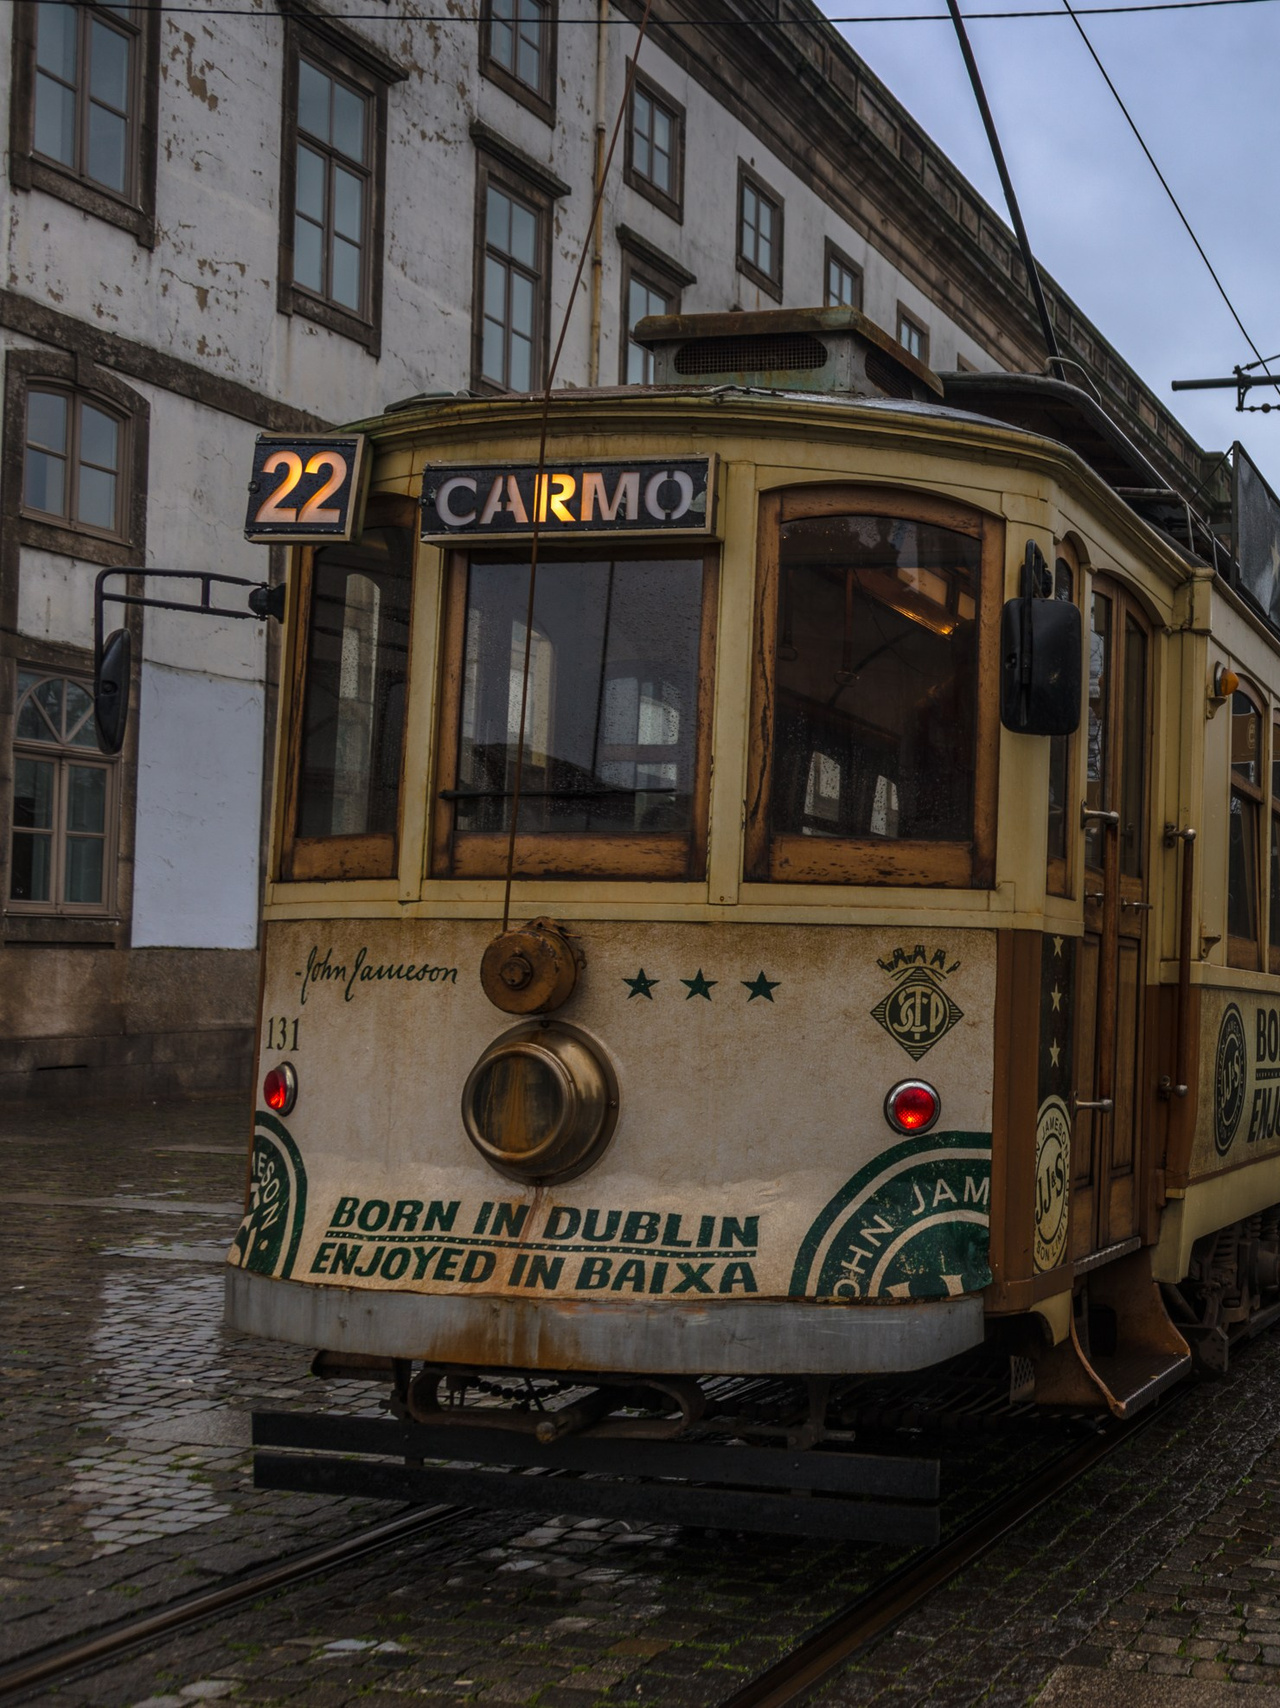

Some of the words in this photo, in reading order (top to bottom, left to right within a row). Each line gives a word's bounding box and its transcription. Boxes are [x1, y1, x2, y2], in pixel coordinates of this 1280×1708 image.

[254, 450, 348, 523] 22
[435, 470, 694, 526] CARMO
[301, 946, 347, 1005] John
[345, 947, 458, 1002] Jameson
[266, 1017, 299, 1051] 131
[1036, 1150, 1065, 1225] JJ&S
[329, 1196, 461, 1233] BORN
[473, 1201, 532, 1238] IN
[541, 1206, 760, 1248] DUBLIN
[309, 1242, 497, 1284] ENJOYED
[508, 1253, 566, 1290] IN
[574, 1256, 759, 1294] BAIXA
